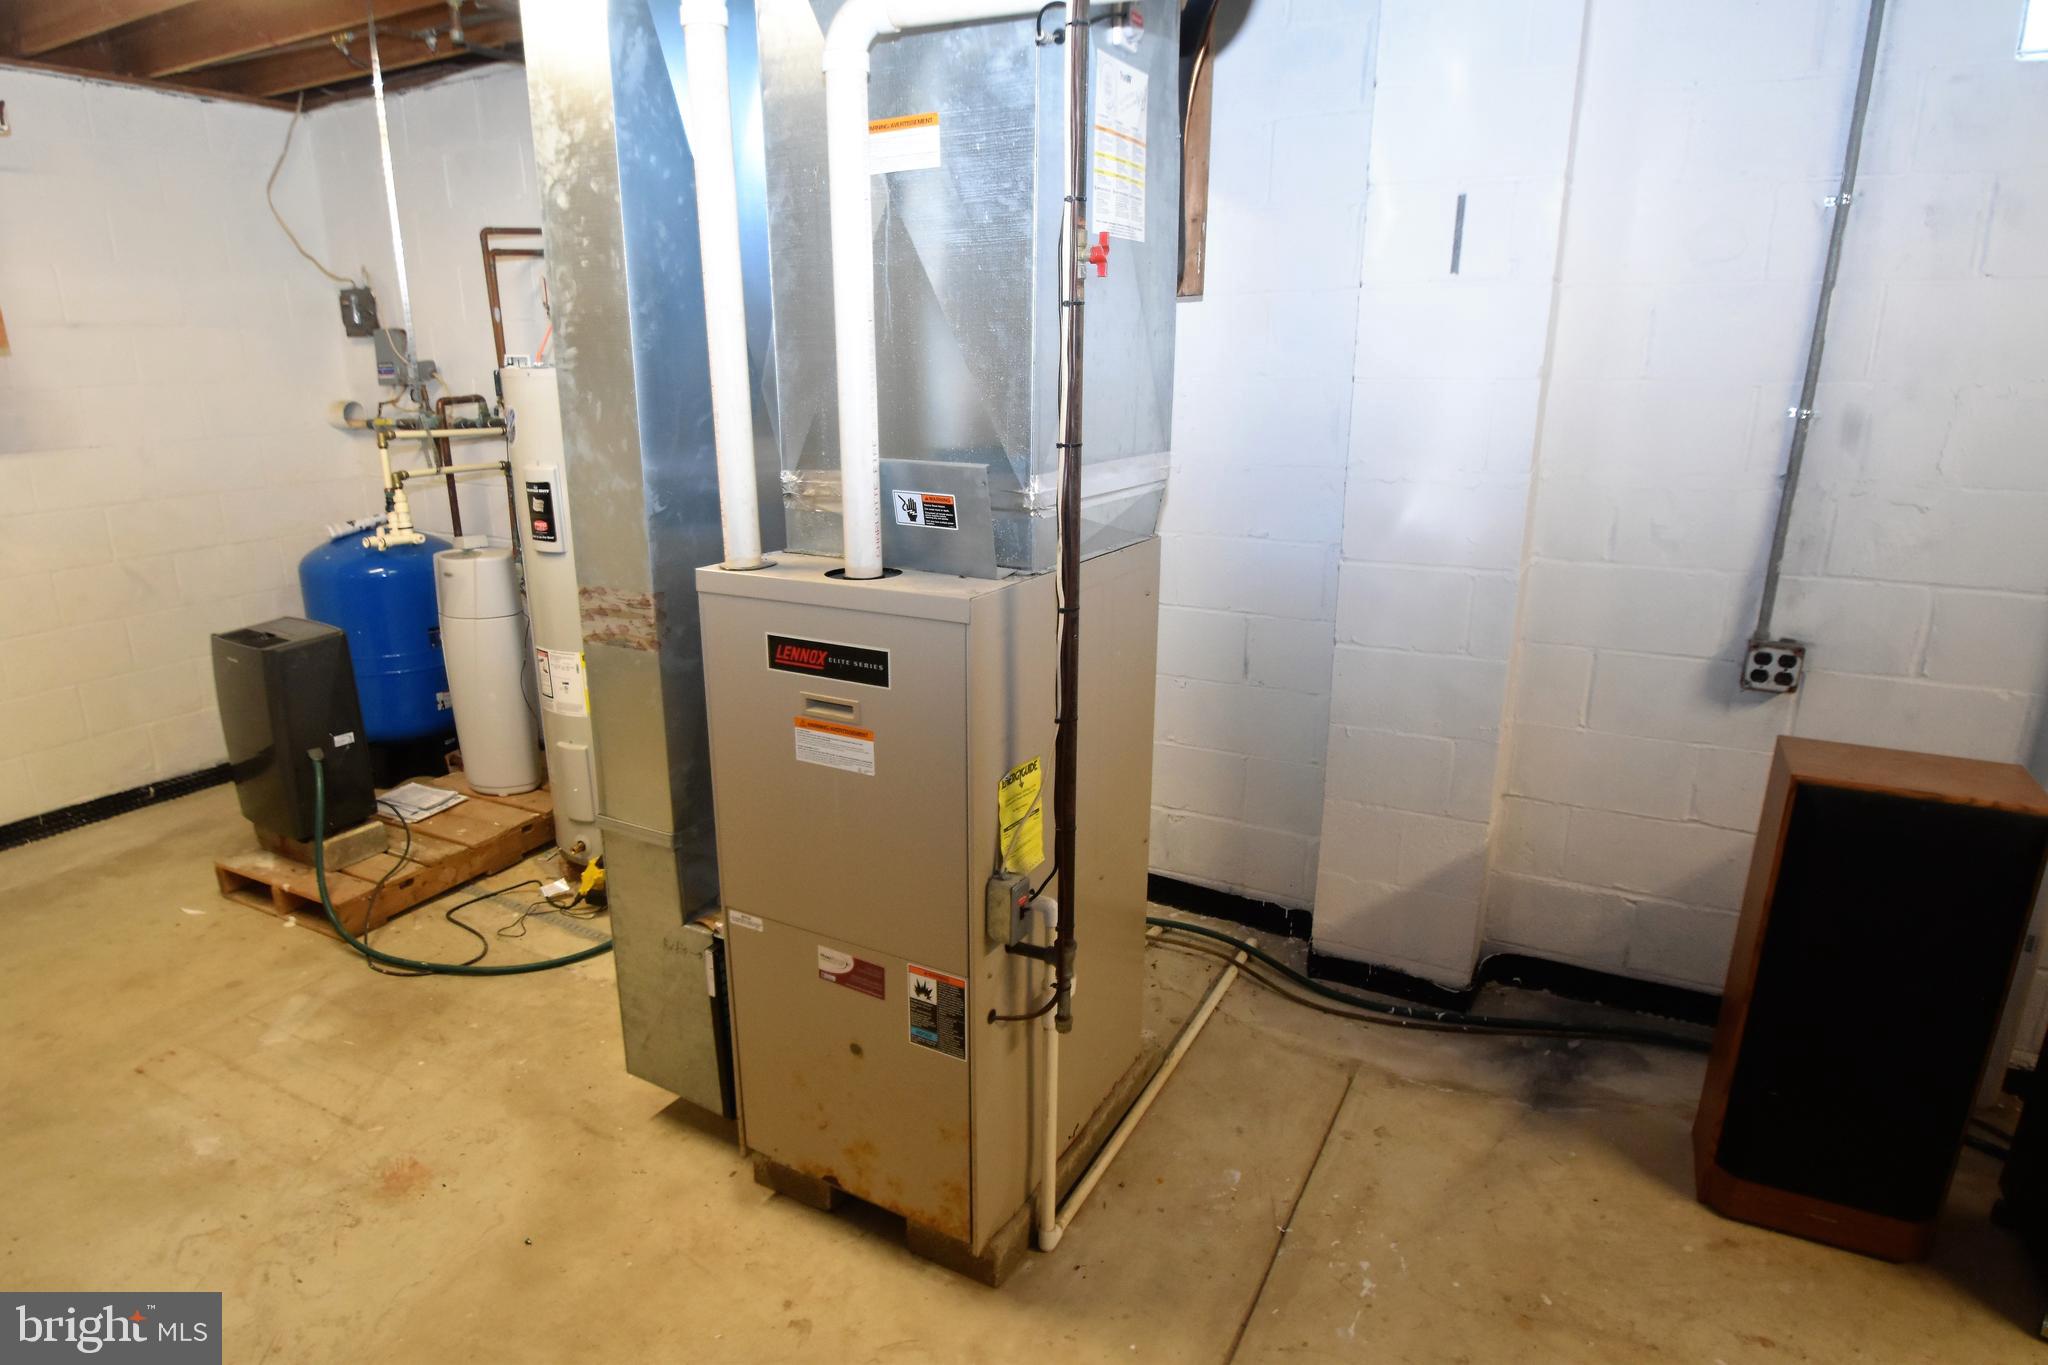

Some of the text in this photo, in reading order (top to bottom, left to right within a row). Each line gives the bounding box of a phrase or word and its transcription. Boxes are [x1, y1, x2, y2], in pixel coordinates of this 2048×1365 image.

[775, 644, 884, 671] LENNOX ELITE SERIES
